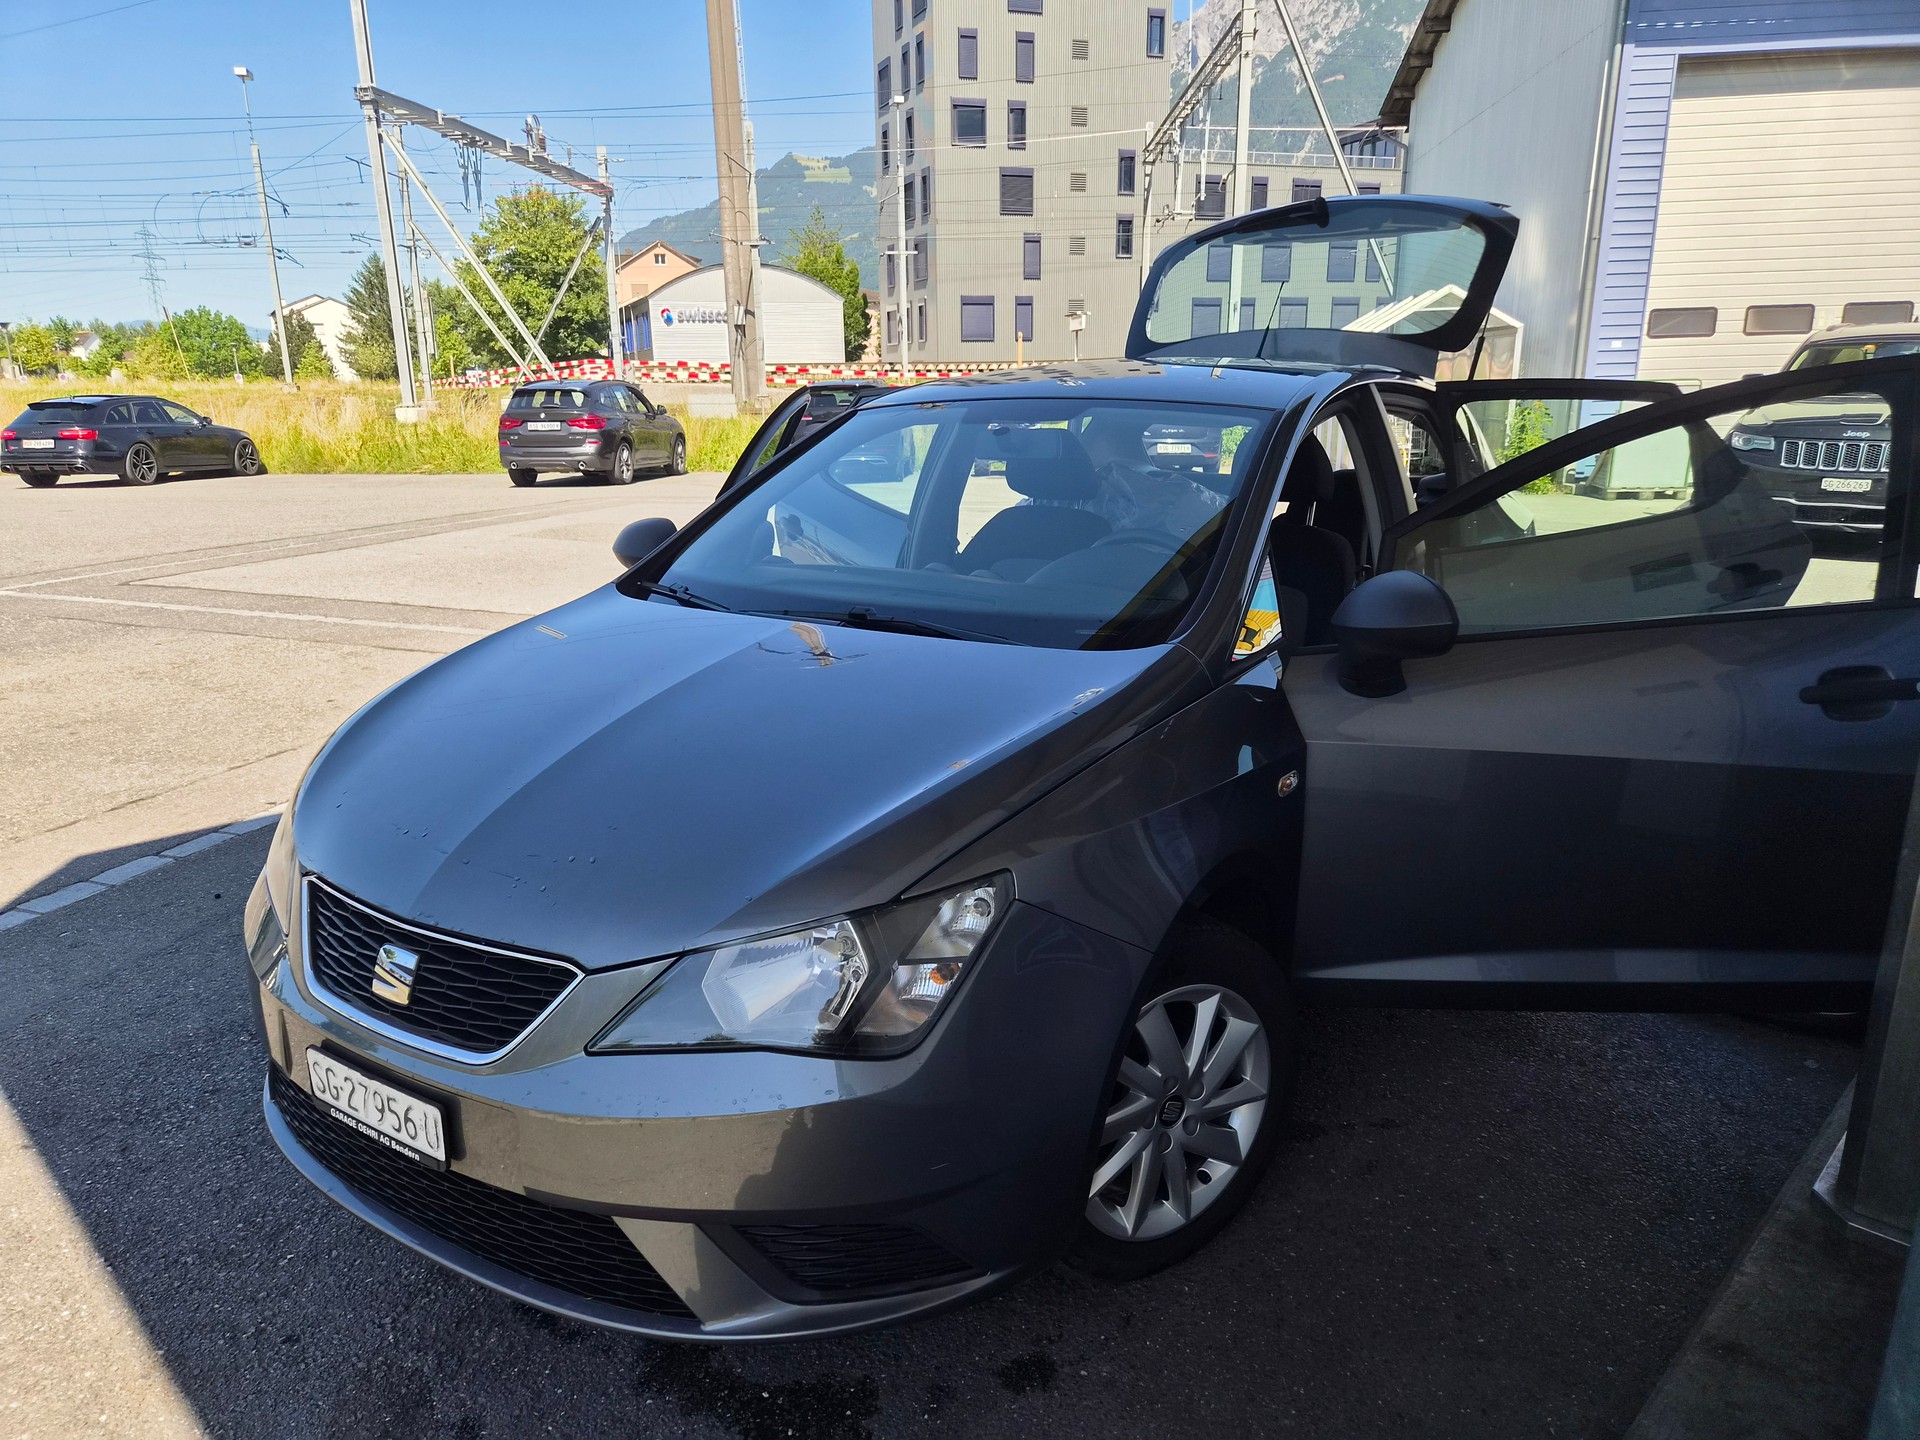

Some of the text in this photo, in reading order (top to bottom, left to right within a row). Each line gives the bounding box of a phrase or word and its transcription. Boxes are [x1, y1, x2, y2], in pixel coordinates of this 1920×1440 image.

[677, 307, 728, 324] swissco
[1842, 430, 1870, 438] Jeep
[330, 1108, 420, 1161] GARAGE OEHRI AG Bendern
